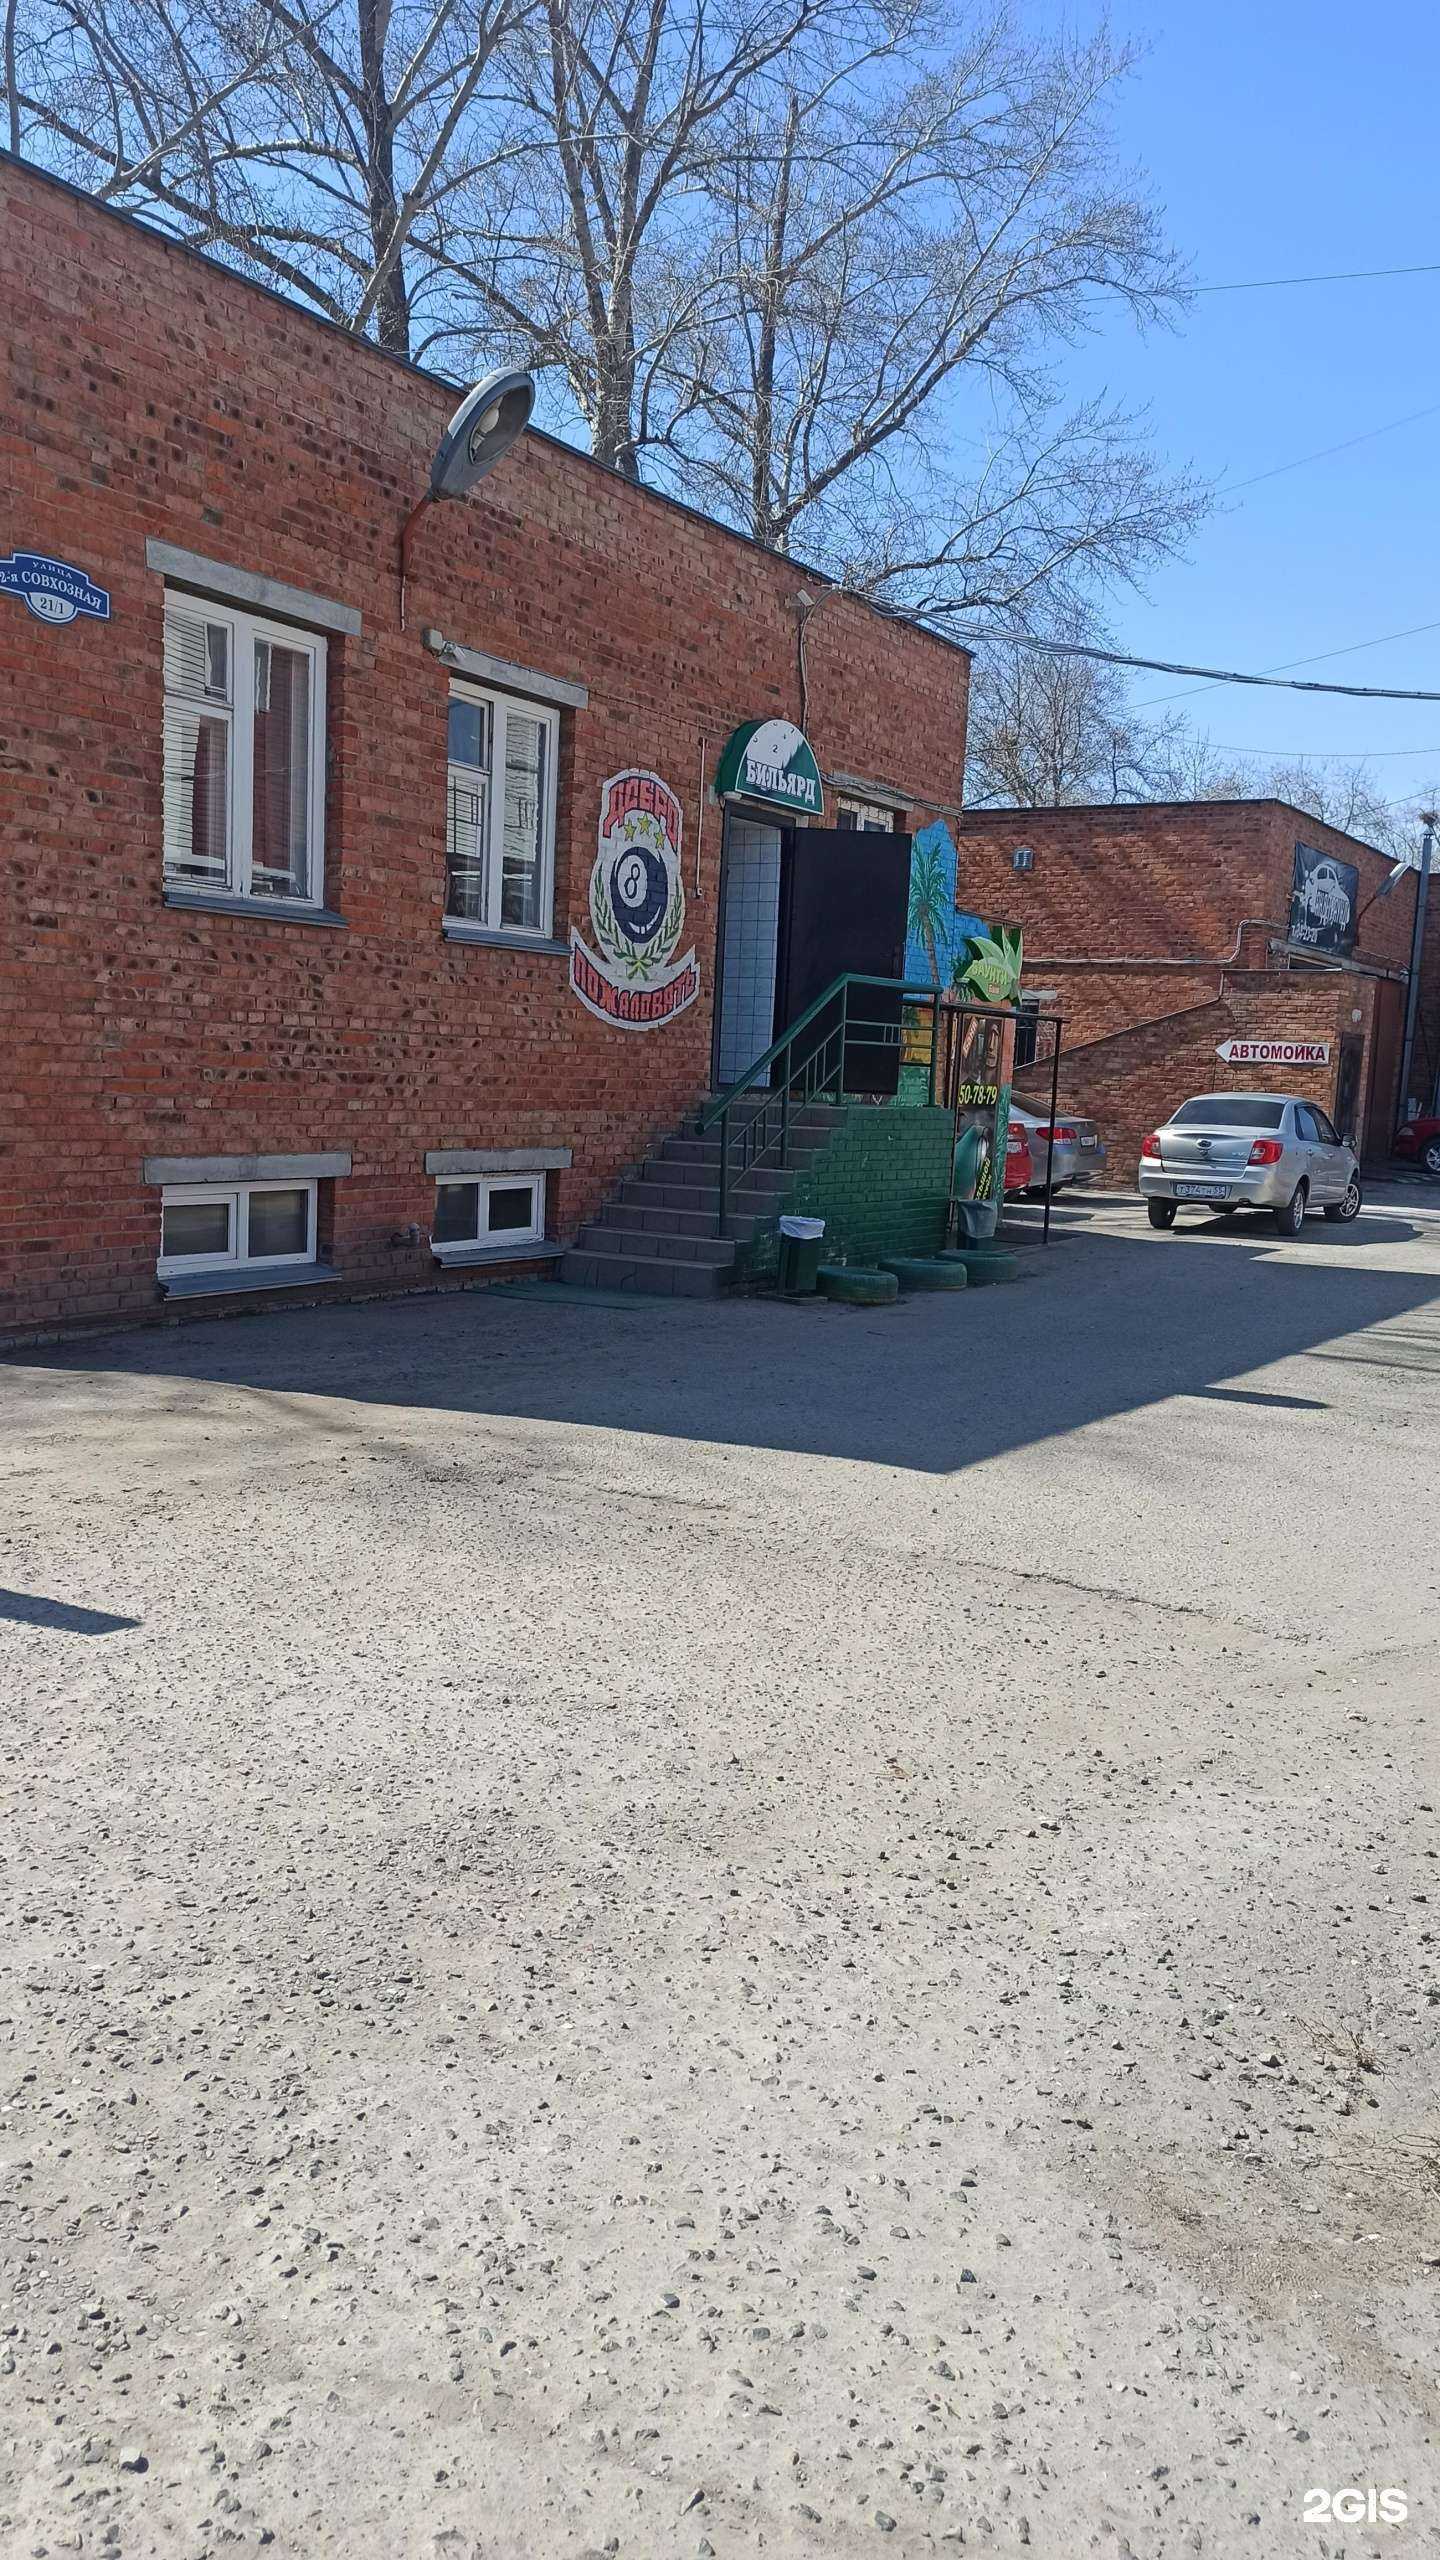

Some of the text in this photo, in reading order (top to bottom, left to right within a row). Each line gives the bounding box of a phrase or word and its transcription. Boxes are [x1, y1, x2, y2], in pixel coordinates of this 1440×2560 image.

[32, 561, 73, 579] УЛИЦА
[21, 571, 102, 610] СОВХОЗНАЯ
[40, 597, 64, 615] 21/1
[746, 759, 816, 806] БИЛЬЯРД
[602, 776, 680, 855] ДОБРО
[623, 862, 641, 899] 8
[573, 942, 697, 1023] ПОЖАЛОВАТЬ
[1229, 1044, 1326, 1061] АВТОМОЙКА
[958, 1084, 998, 1105] 50-78-79
